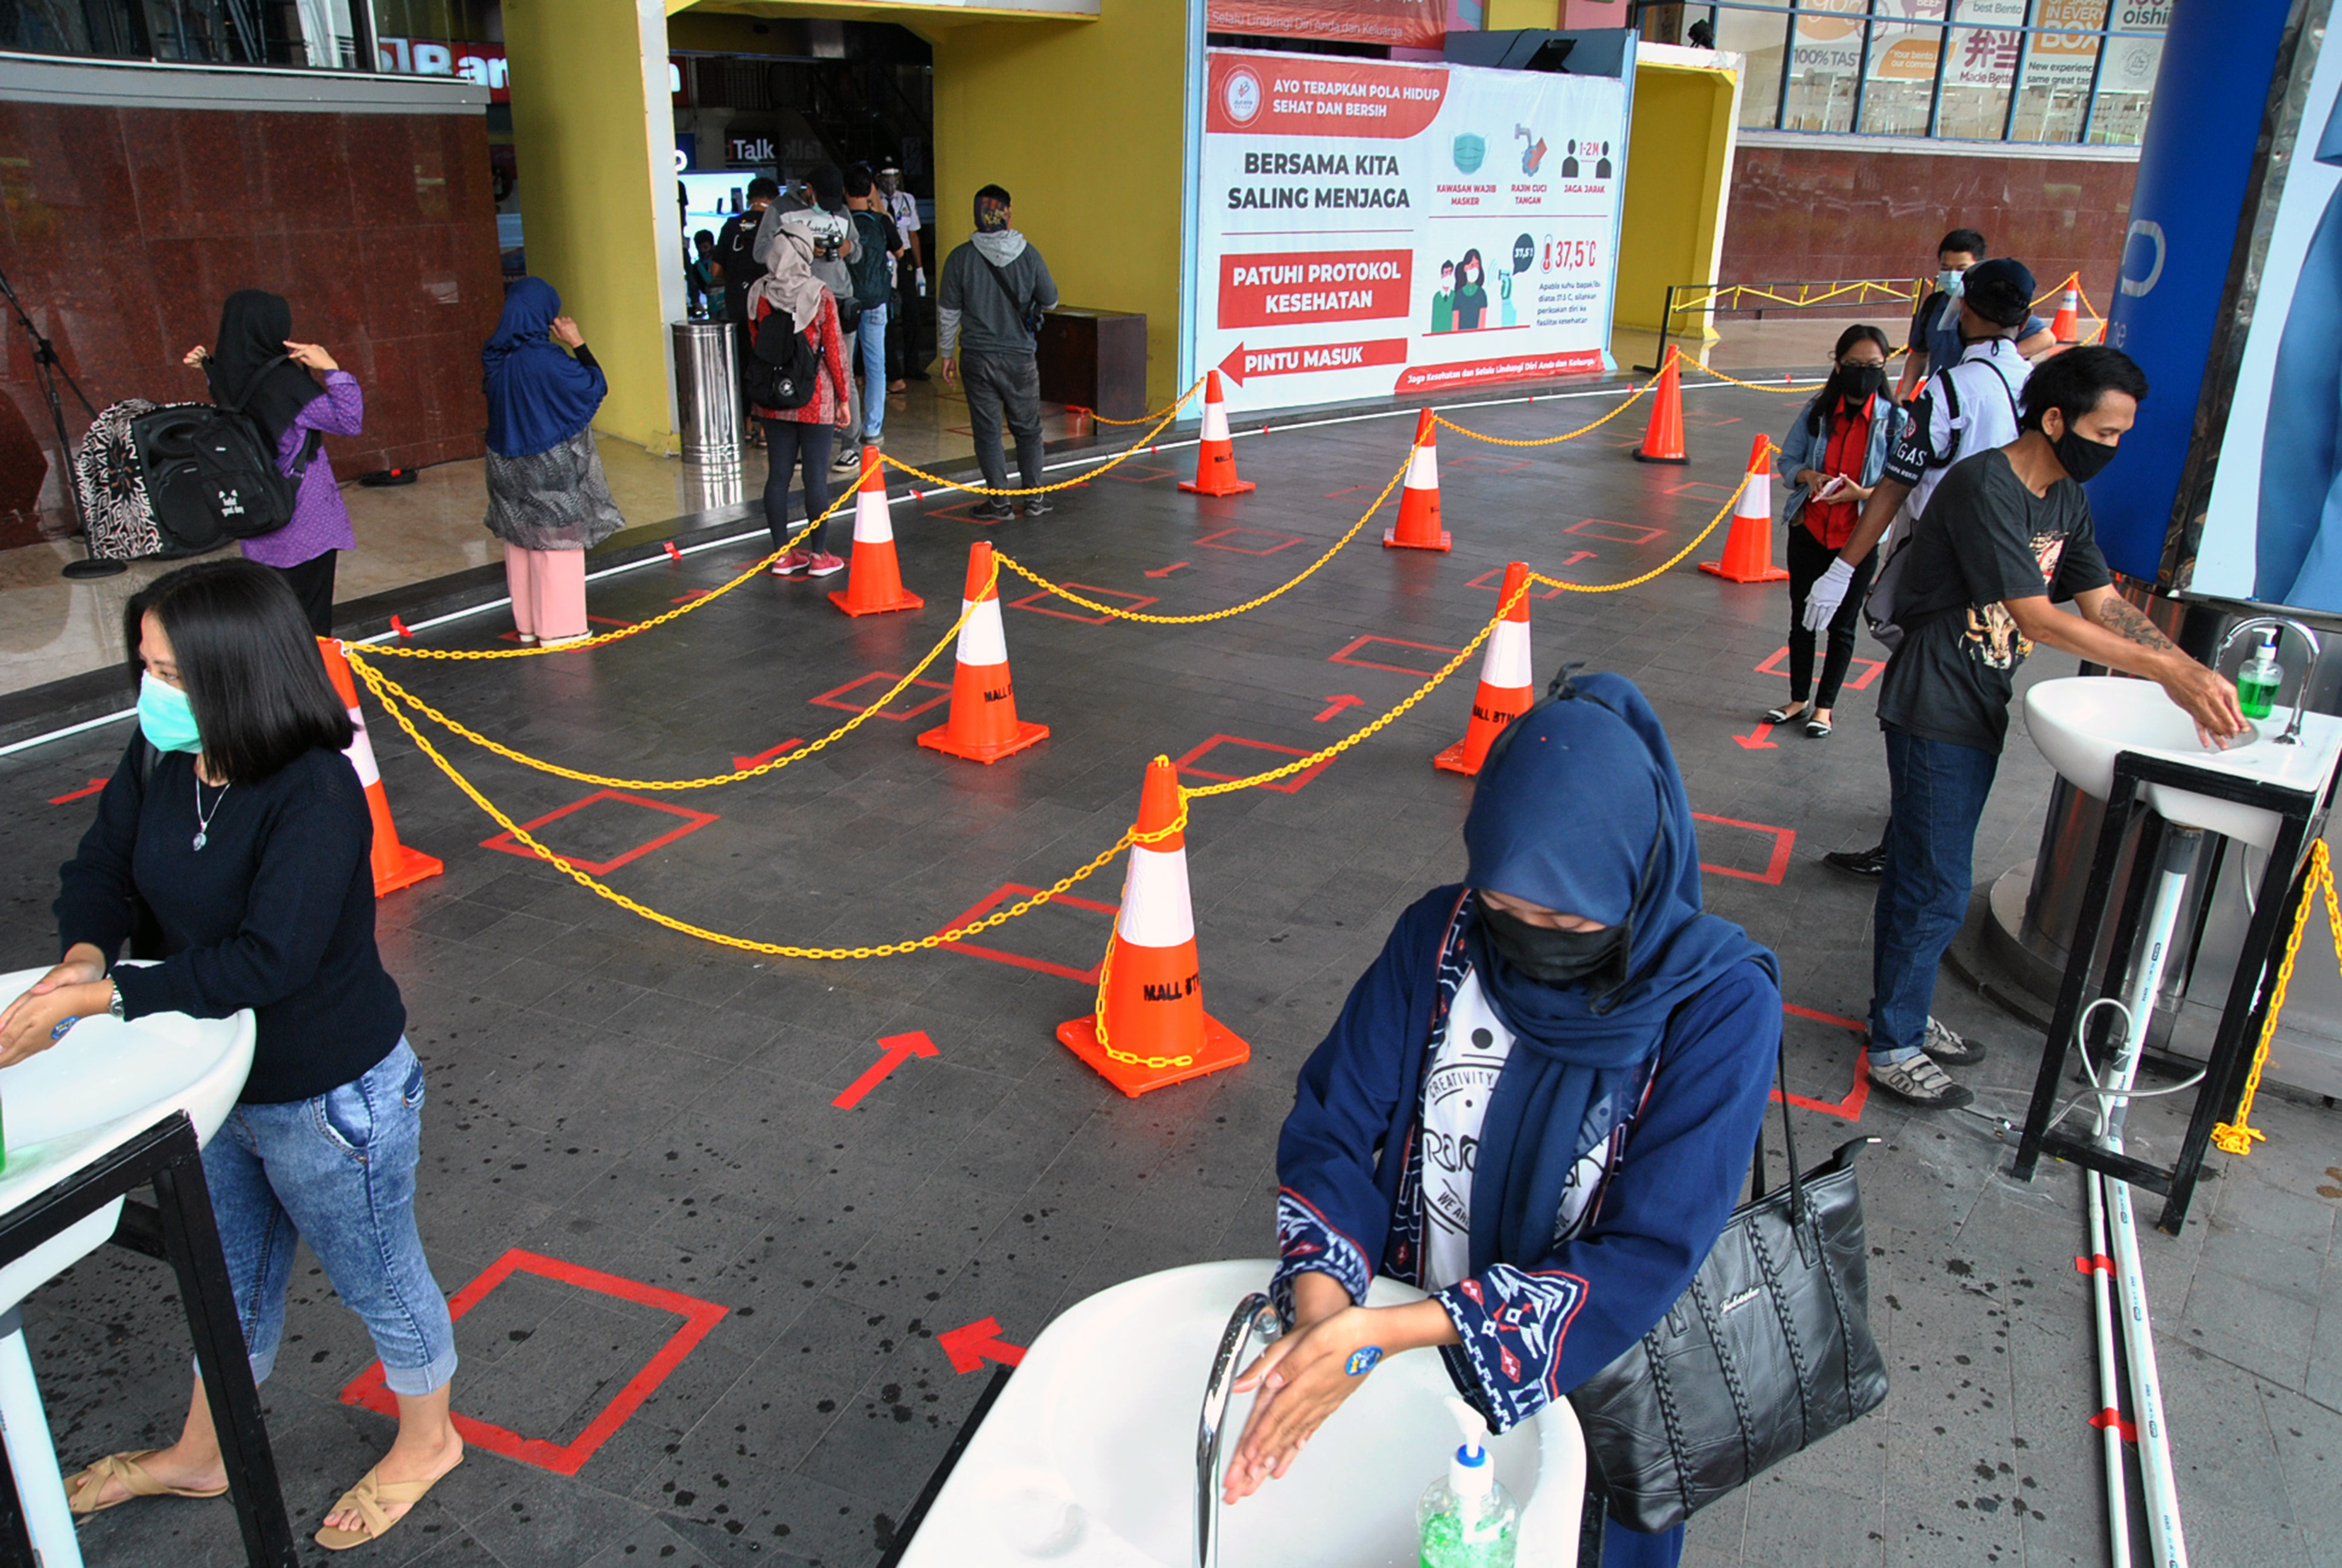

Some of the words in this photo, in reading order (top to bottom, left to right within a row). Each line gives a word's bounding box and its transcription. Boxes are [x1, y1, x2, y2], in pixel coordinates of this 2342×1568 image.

[1973, 3, 1992, 13] best
[1995, 4, 2022, 14] Bento
[2046, 5, 2061, 19] IN
[2062, 6, 2106, 20] EVERY
[1211, 11, 1244, 25] Selalu
[1248, 13, 1293, 31] Lindungi
[1295, 18, 1312, 30] Diri
[1316, 19, 1340, 32] Anda
[1342, 22, 1360, 34] dan
[1364, 23, 1403, 39] Keluarga
[2040, 20, 2103, 49] BOX
[1793, 49, 1829, 66] 100%
[2028, 62, 2048, 71] New
[1960, 71, 1987, 82] Made
[2027, 76, 2048, 84] same
[2051, 76, 2075, 85] great
[1273, 79, 1300, 94] AYO
[1303, 80, 1367, 97] TERAPKAN
[1369, 85, 1401, 99] POLA
[1403, 87, 1440, 101] HIDUP
[1273, 99, 1314, 114] SEHAT
[1316, 101, 1343, 115] DAN
[1345, 103, 1388, 117] BERSIH
[1244, 153, 1350, 174] BERSAMA
[1355, 155, 1399, 176] KITA
[1436, 184, 1472, 193] KAWASAN
[1473, 184, 1497, 193] WAJIB
[1511, 184, 1530, 193] RAJIN
[1532, 184, 1547, 193] CUCI
[1564, 185, 1582, 193] JAGA
[1584, 185, 1605, 193] JARAK
[1228, 187, 1309, 210] SALING
[1314, 188, 1410, 208] MENJAGA
[1451, 197, 1480, 206] MASKER
[1515, 196, 1542, 205] TANGAN
[1233, 265, 1303, 286] PATUHI
[1308, 262, 1402, 283] PROTOKOL
[1265, 290, 1373, 314] KESEHATAN
[1244, 352, 1299, 373] PINTU
[1304, 347, 1364, 368] MASUK
[1407, 375, 1426, 385] Jaga
[1426, 370, 1461, 382] Kesehatan
[1463, 368, 1474, 378] dan
[1475, 367, 1495, 376] Selalu
[1496, 362, 1524, 375] Lindungi
[1525, 361, 1538, 371] Diri
[1555, 360, 1567, 368] dan
[1143, 981, 1183, 1002] MALL
[1429, 1071, 1494, 1099] CREATIVITY
[1437, 1191, 1455, 1211] WE
